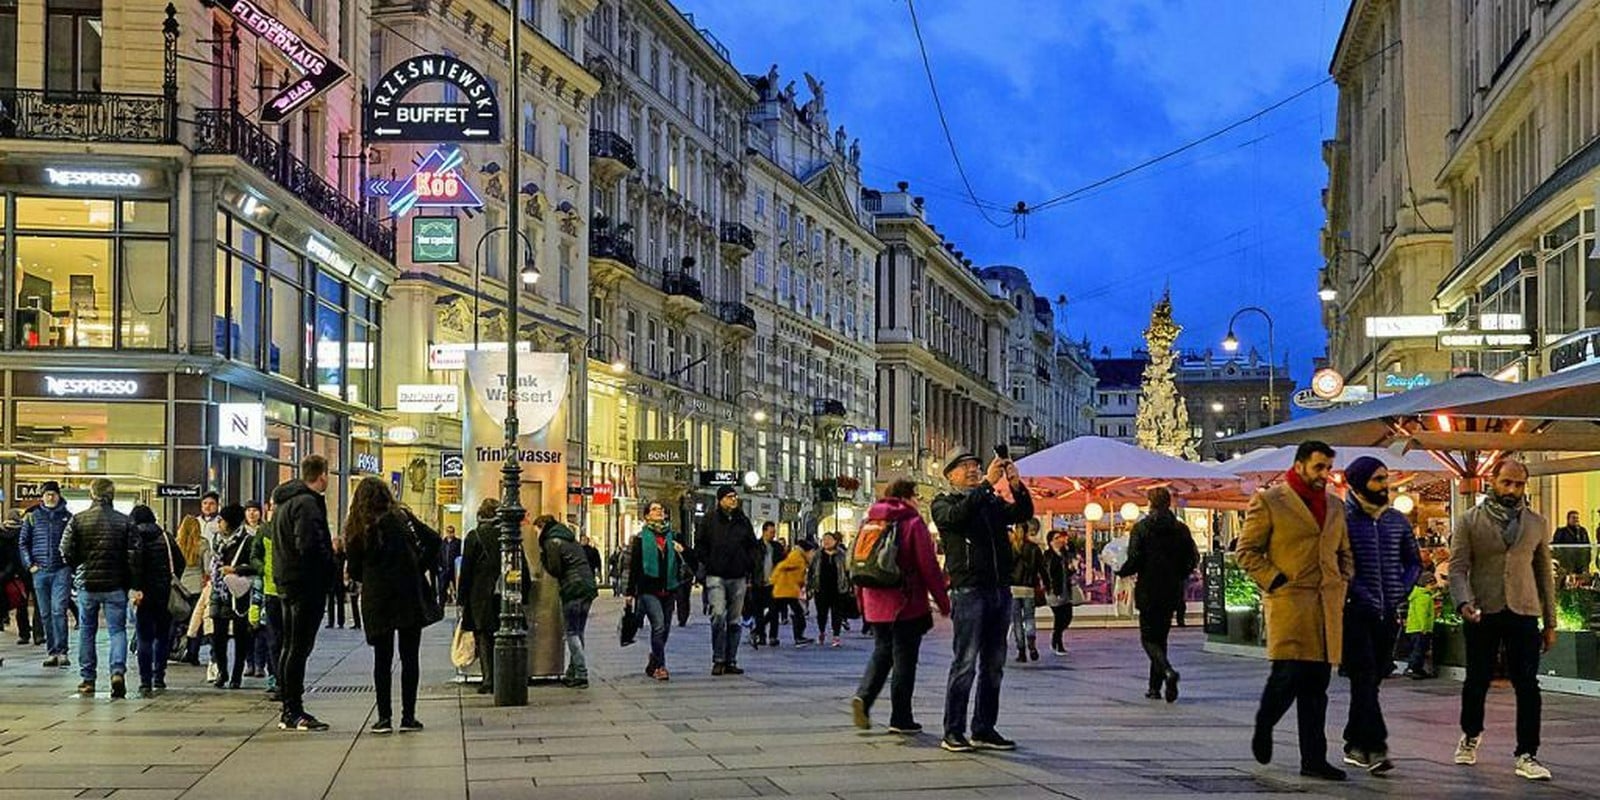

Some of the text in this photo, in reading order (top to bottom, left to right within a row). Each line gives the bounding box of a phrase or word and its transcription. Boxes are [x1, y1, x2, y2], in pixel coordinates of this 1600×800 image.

[231, 1, 325, 76] FLEDERMAUS
[287, 80, 313, 100] BAR
[396, 107, 469, 123] BUFFET
[46, 168, 141, 187] NESPRESSO
[43, 375, 138, 396] NESPRESSO
[648, 450, 680, 462] BONITA
